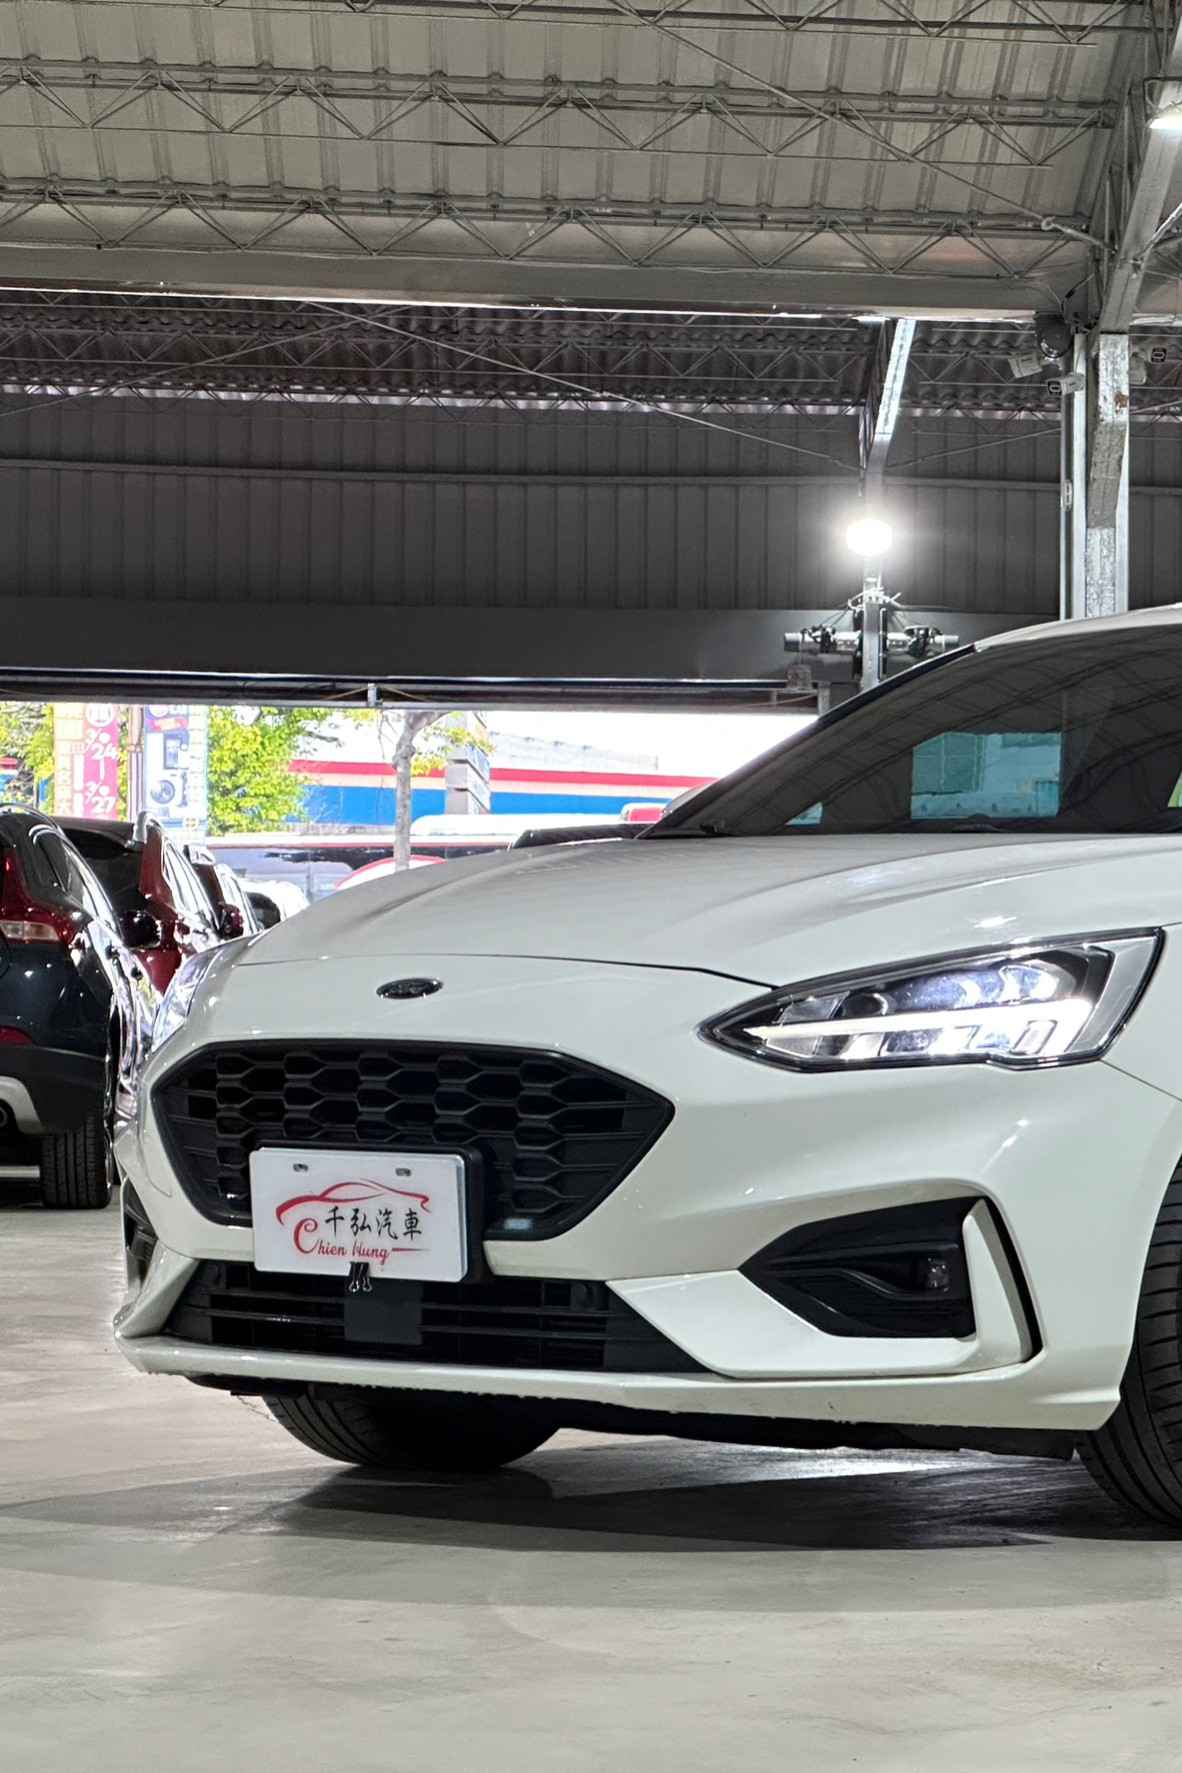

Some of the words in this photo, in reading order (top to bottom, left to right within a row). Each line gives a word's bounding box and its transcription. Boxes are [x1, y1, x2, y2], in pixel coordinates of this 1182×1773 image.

[293, 1218, 348, 1255] Chien
[352, 1240, 390, 1265] Hung
[325, 1205, 422, 1241] 千弘汽車
